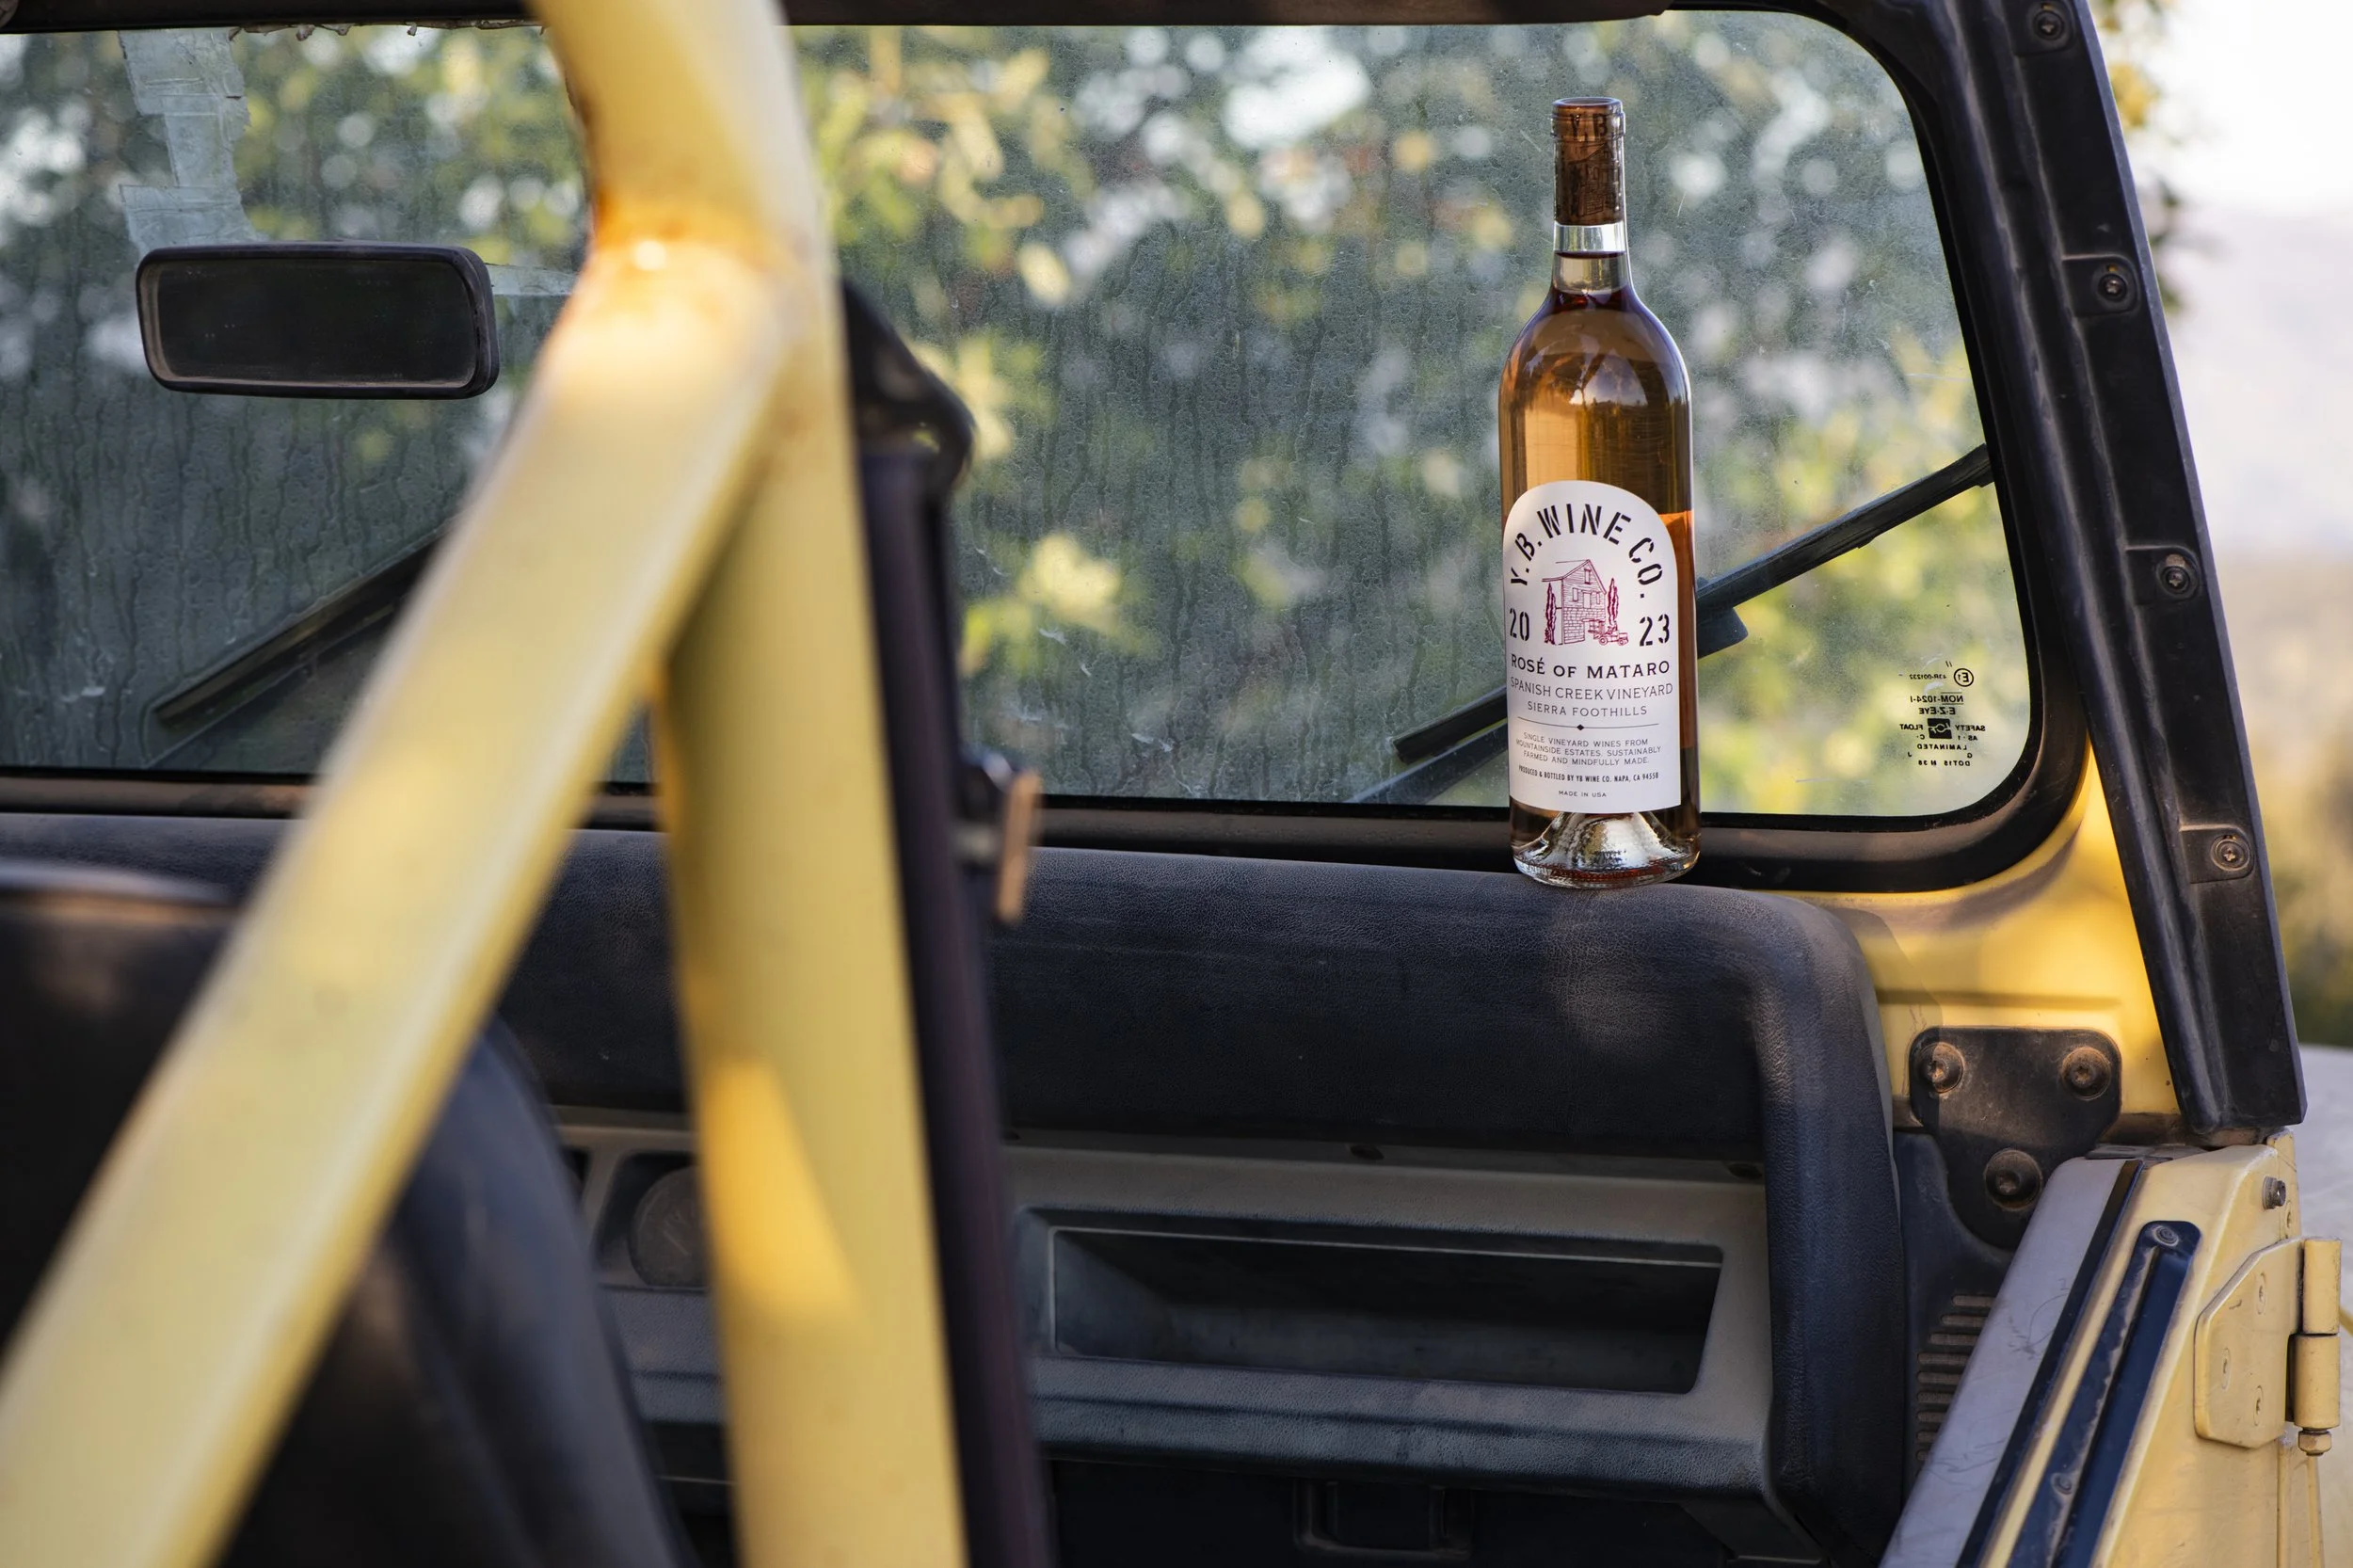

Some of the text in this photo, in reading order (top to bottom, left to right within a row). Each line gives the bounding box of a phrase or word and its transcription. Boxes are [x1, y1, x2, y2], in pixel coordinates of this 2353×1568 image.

[1537, 504, 1631, 545] WINE
[1628, 537, 1663, 599] CO.
[1510, 608, 1670, 647] 20 23
[1511, 653, 1670, 679] ROSÉ OF MATARO
[1511, 677, 1673, 700] SPANISH CREEK VINEYARD
[1528, 701, 1647, 717] SIERRA FOOTHILLS
[1515, 739, 1561, 754] MOUNTAINSIDE
[1607, 746, 1661, 757] SUSTAINABLY
[1524, 731, 1545, 743] SINGLE
[1548, 738, 1589, 747] VINEYARD
[1523, 750, 1548, 762] FARMED
[1551, 756, 1568, 764] AND
[1518, 764, 1538, 776] PRODUCED
[1544, 771, 1565, 781] BOTTLED
[1642, 772, 1659, 780] 94558
